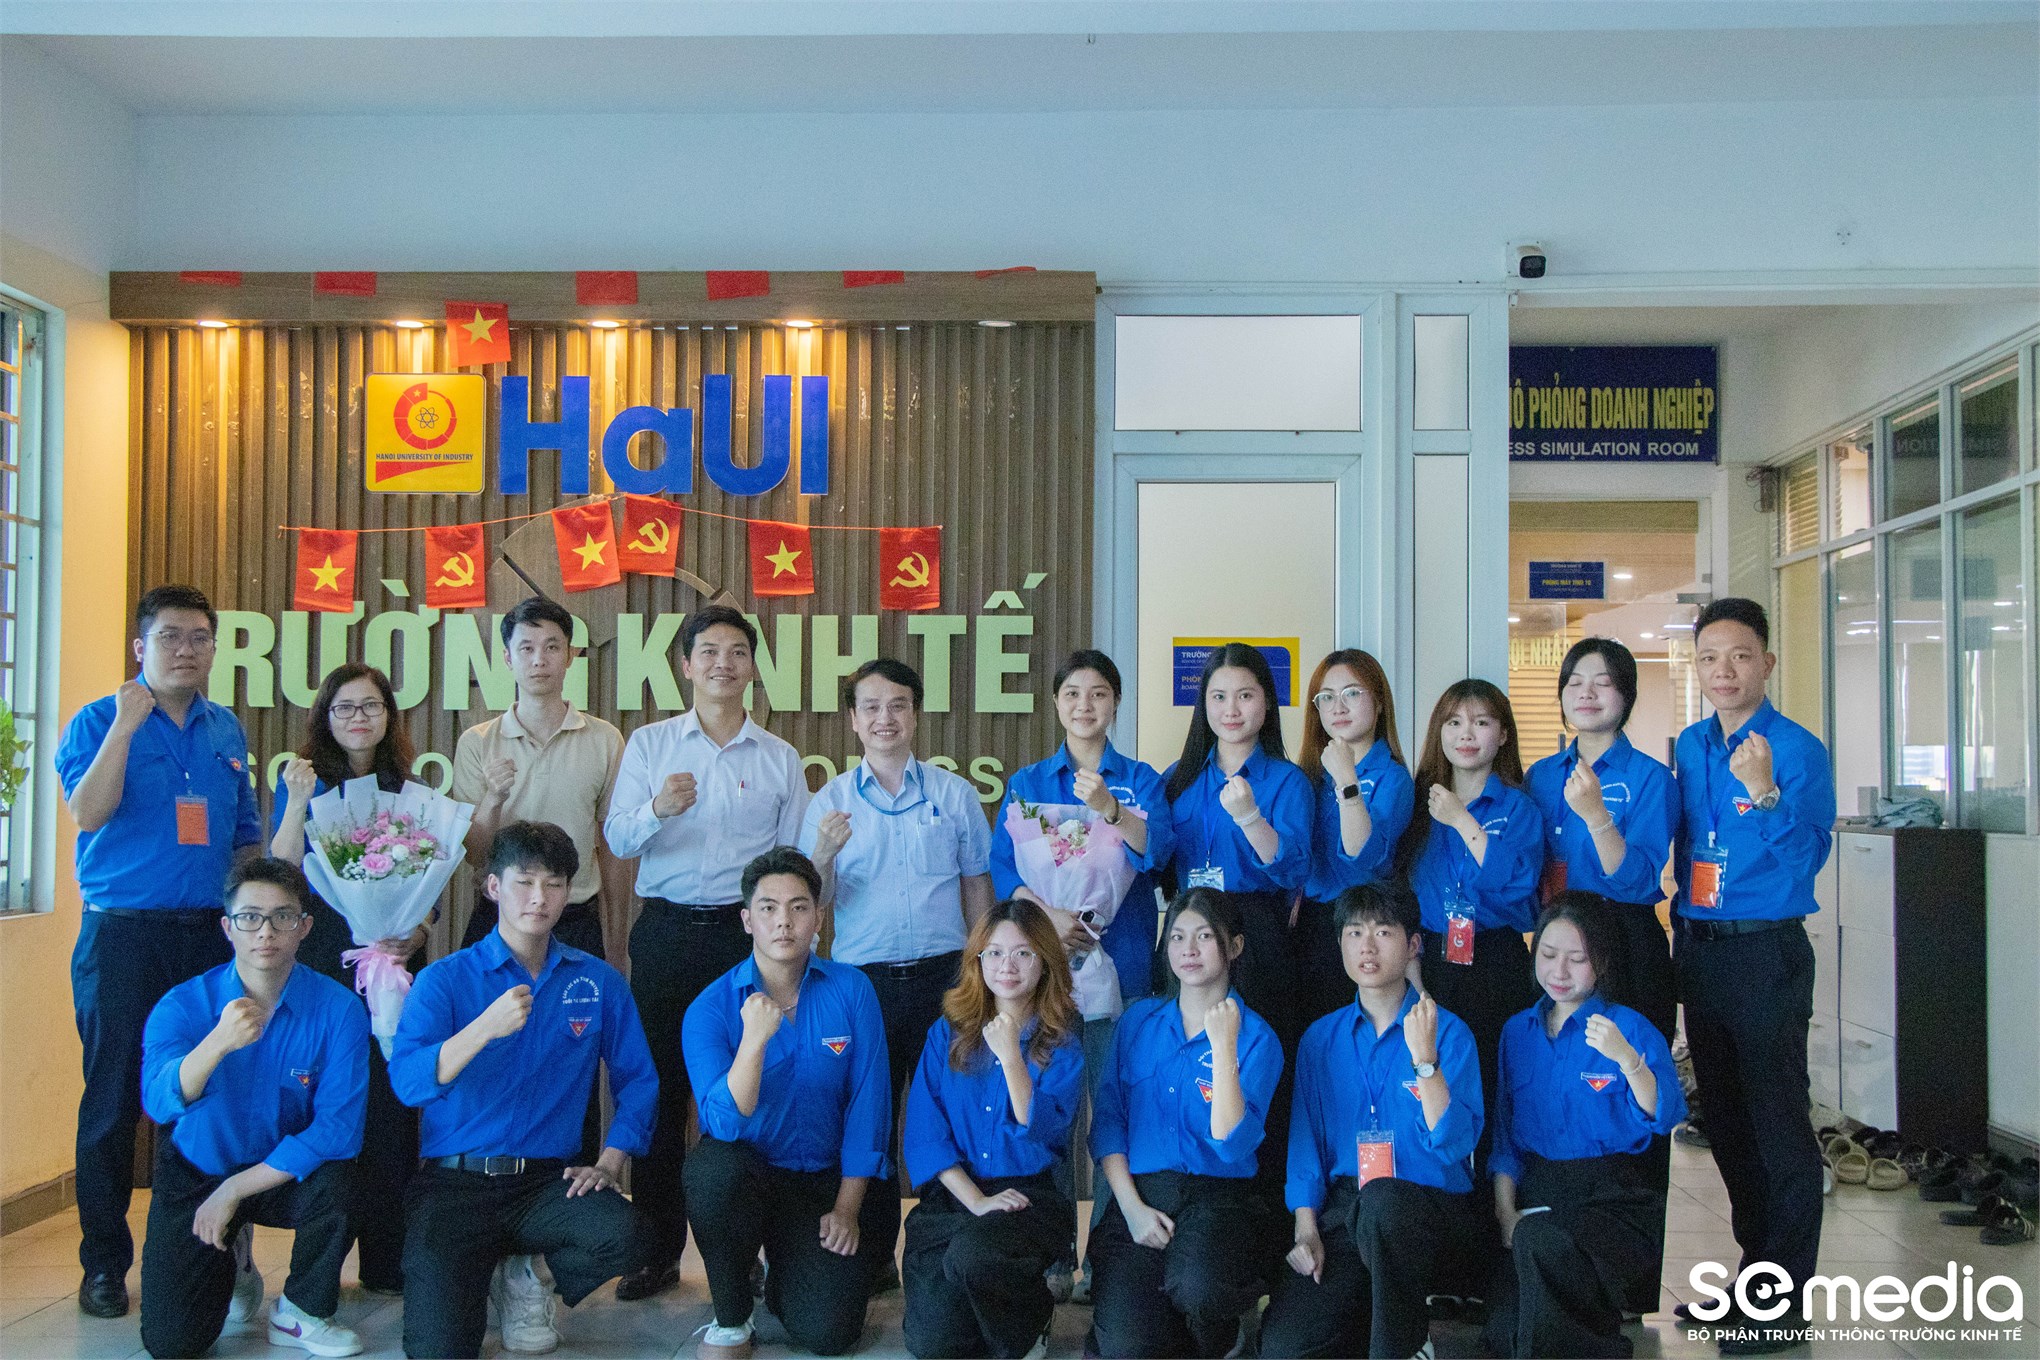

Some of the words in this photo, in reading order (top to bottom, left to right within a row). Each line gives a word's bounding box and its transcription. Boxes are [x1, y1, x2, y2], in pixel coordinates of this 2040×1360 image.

[1528, 372, 1587, 429] PHỎNG
[1590, 387, 1649, 429] DOANH
[1653, 378, 1715, 435] NGHIỆP
[1540, 442, 1641, 456] SIMULATION
[1647, 442, 1699, 456] ROOM
[617, 613, 879, 713] KNH
[907, 572, 1048, 713] TẾ
